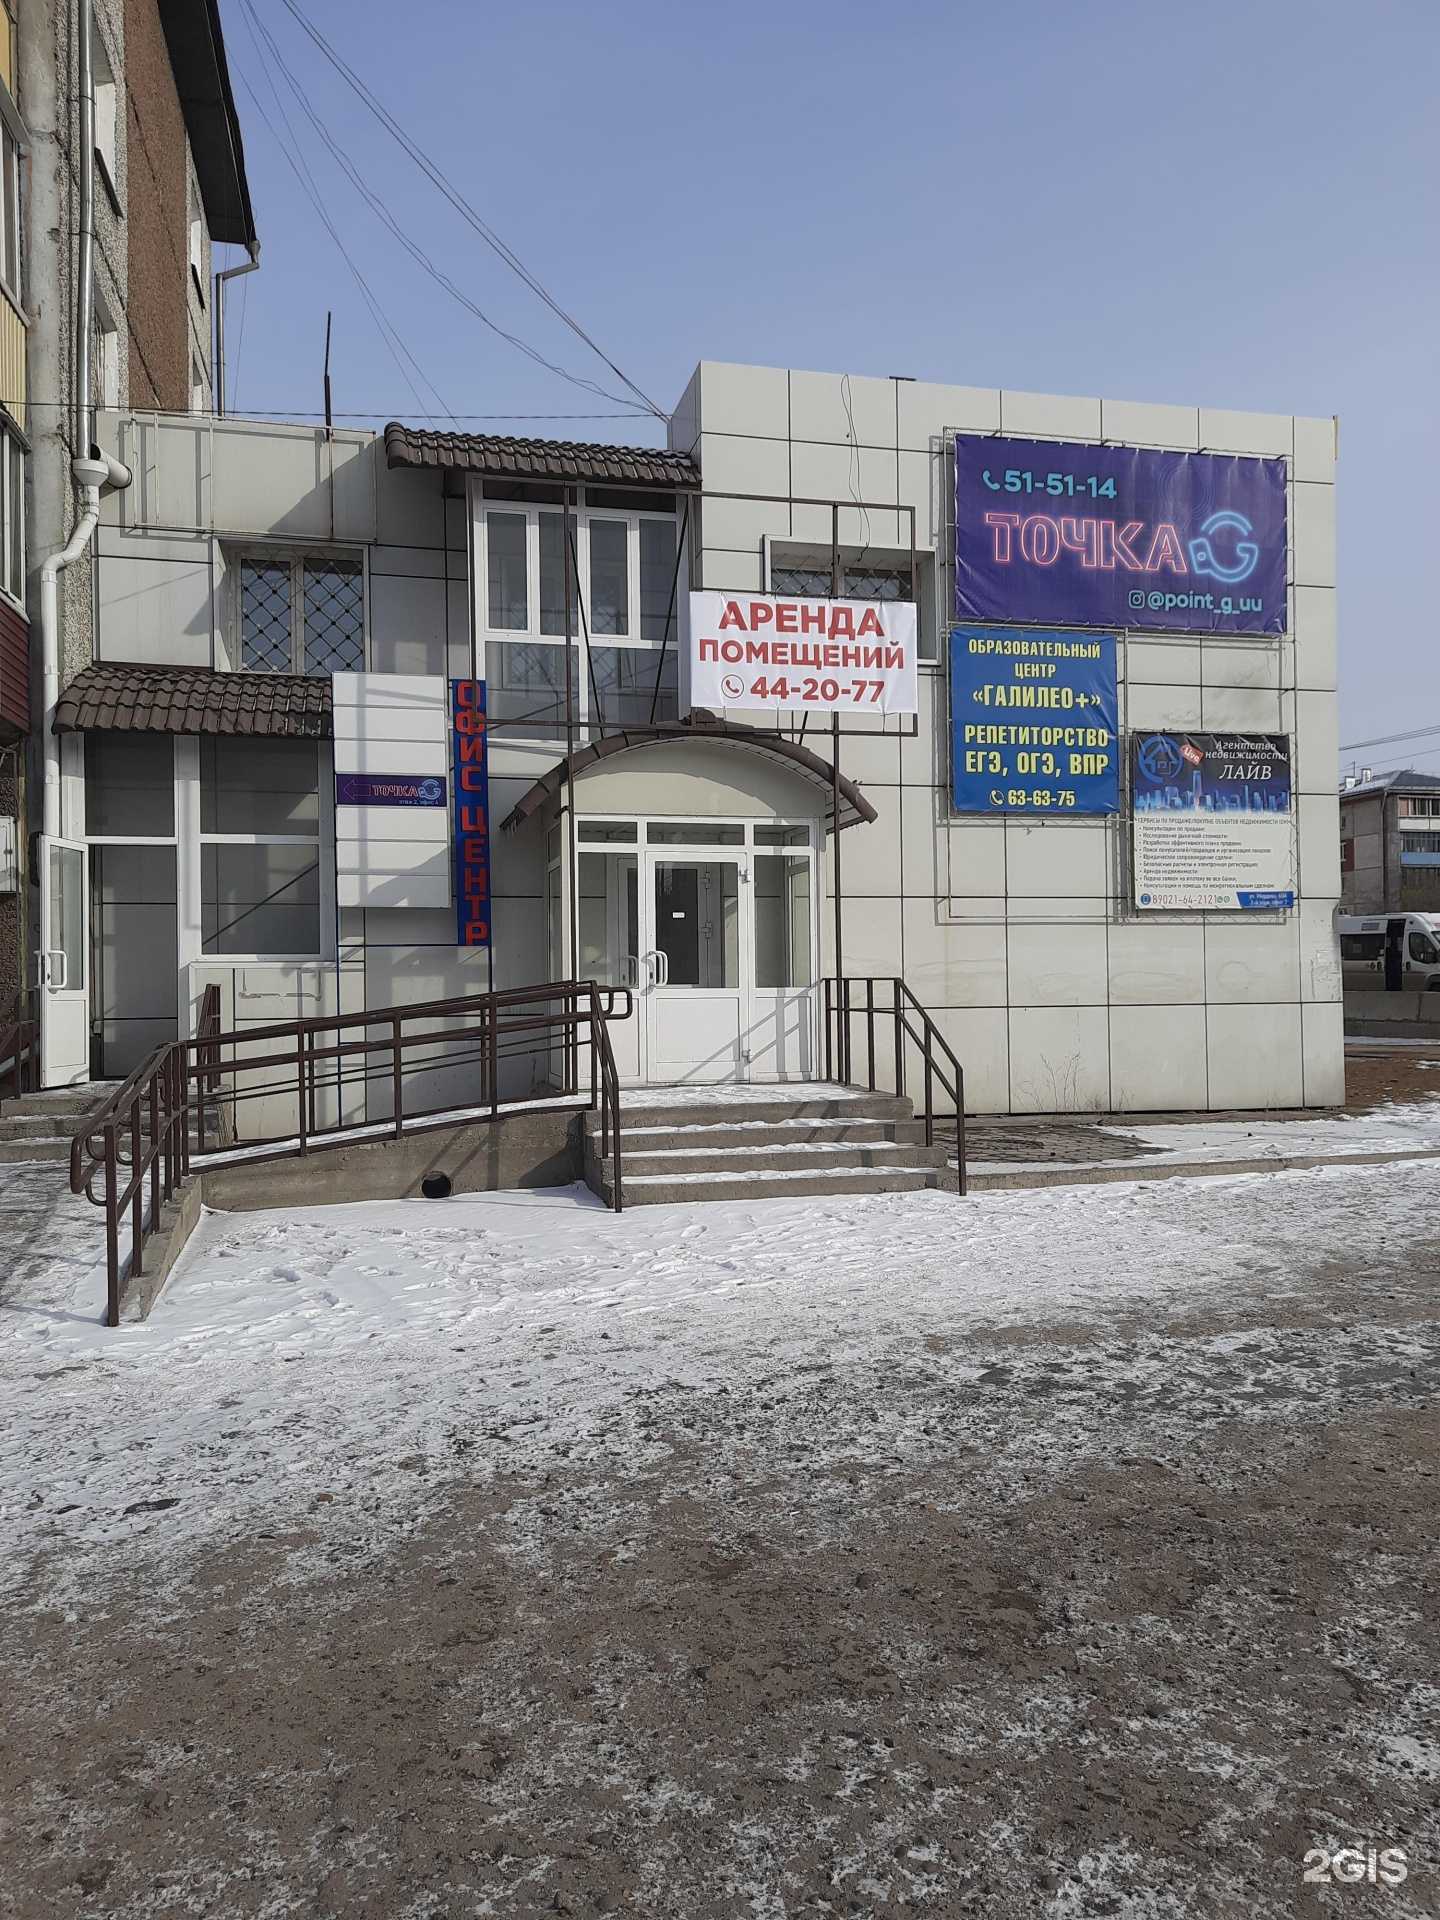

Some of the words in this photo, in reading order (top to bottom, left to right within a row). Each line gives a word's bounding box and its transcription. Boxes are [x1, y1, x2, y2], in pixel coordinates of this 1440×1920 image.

[1004, 470, 1118, 499] 51-51-14
[985, 512, 1188, 573] ТОЧКА
[1147, 590, 1263, 615] @point_g_uu
[718, 600, 885, 641] АРЕНДА
[699, 639, 904, 671] ПОМЕЩЕНИЙ
[968, 638, 1101, 658] ОБРАЗОВАТЕЛЬНЫЙ
[1014, 662, 1057, 679] ЦЕНТР
[750, 676, 885, 703] 44-20-77
[455, 681, 487, 791] ОФИС
[964, 724, 1109, 748] РЕПЕТИТОРСТВО
[965, 751, 1008, 777] ЕГЭ,
[1017, 752, 1062, 778] ОГЭ,
[1069, 753, 1109, 775] ВПР
[1218, 761, 1273, 780] ЛАЙВ
[371, 784, 419, 798] ТОЧКА
[1007, 789, 1076, 807] 63-63-75
[460, 805, 488, 946] ЦЕНТР
